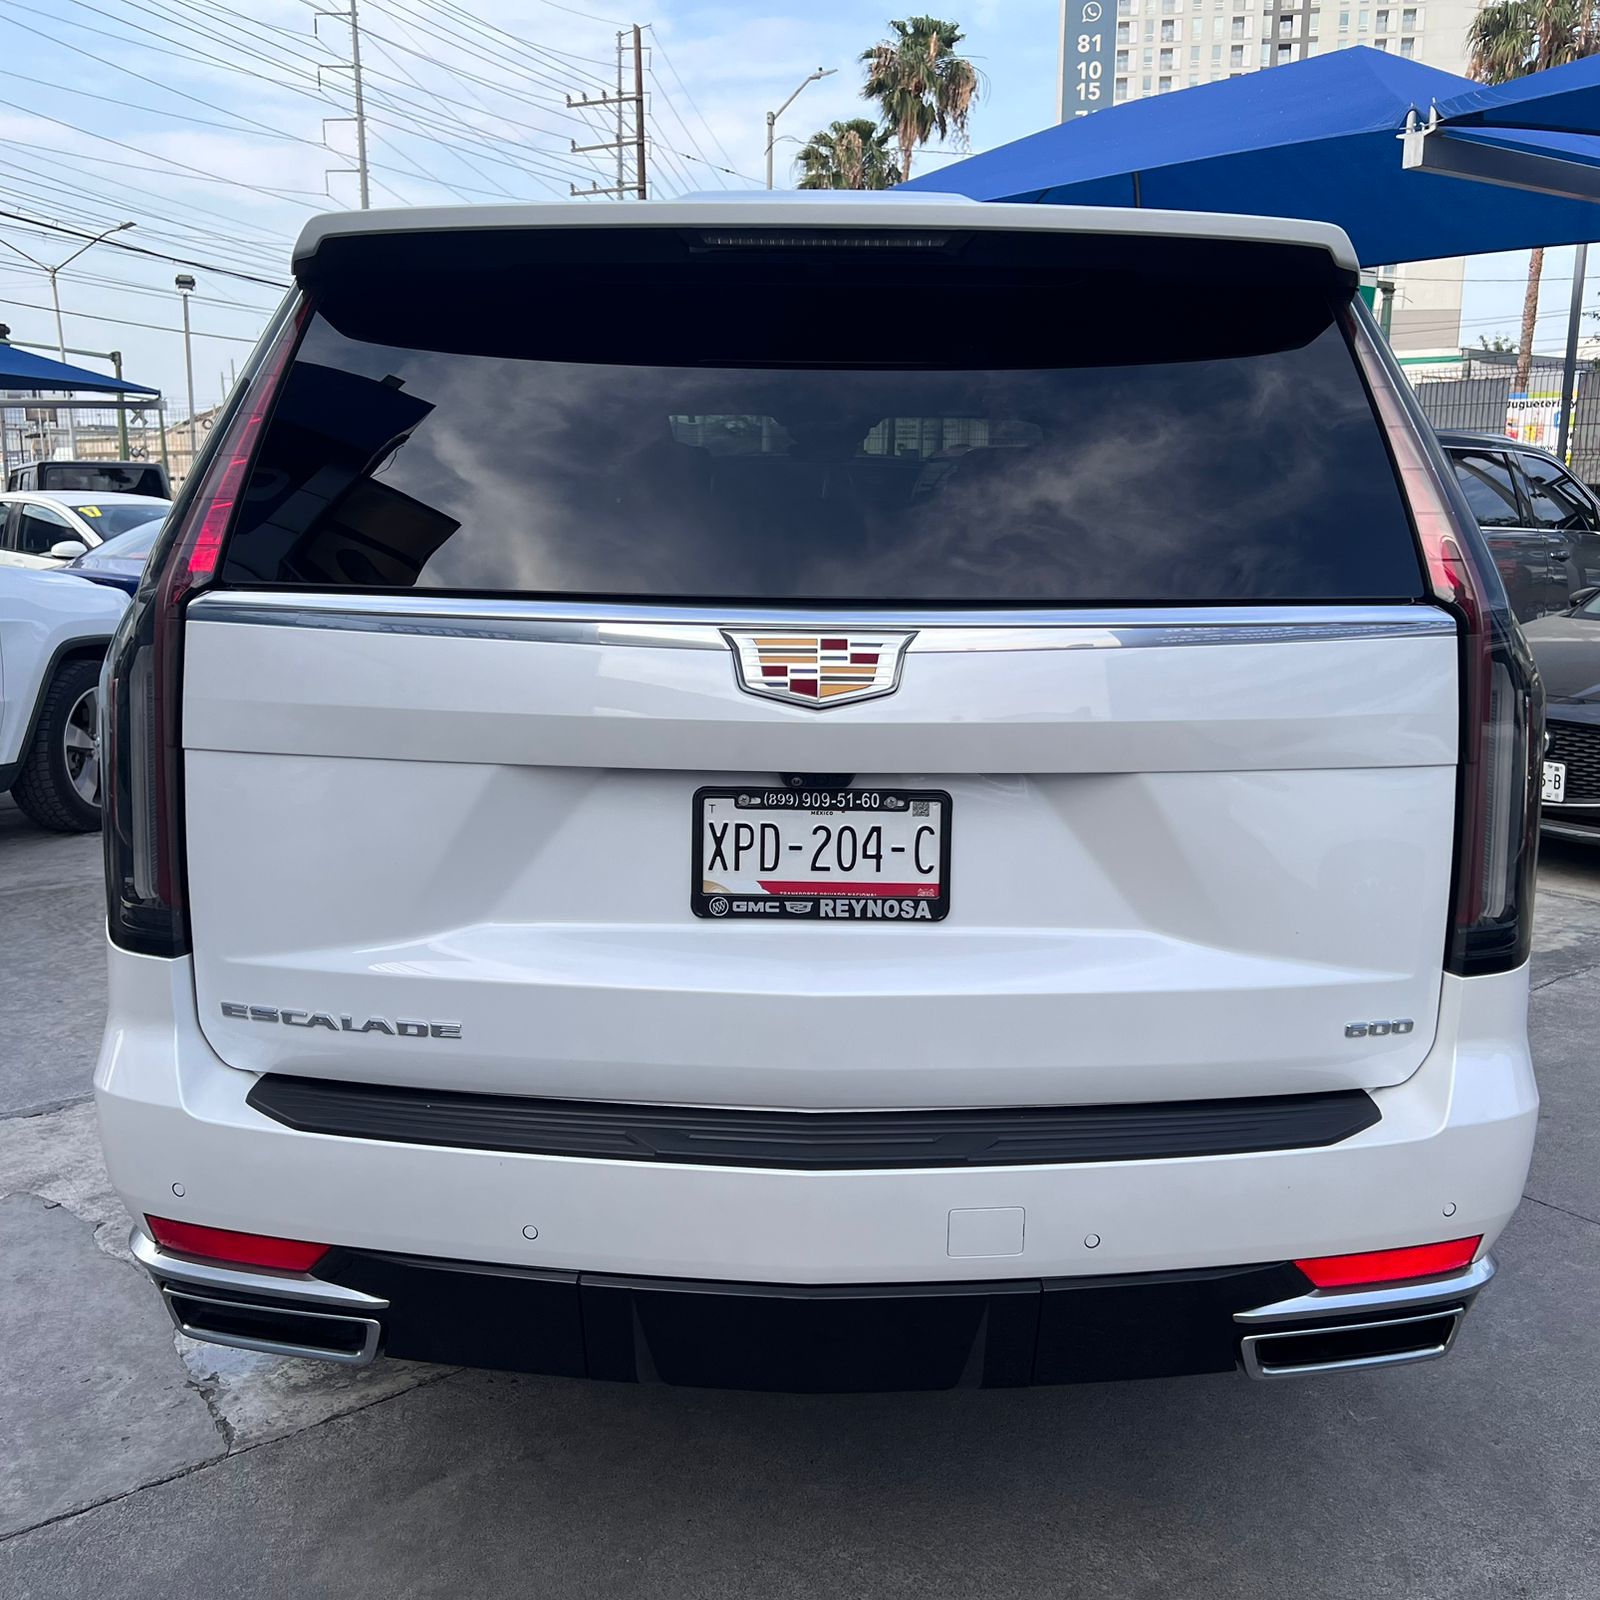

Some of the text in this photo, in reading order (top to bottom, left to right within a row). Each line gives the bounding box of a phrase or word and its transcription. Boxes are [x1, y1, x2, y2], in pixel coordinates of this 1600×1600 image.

[1077, 34, 1101, 53] 81
[1076, 61, 1102, 80] 10
[1076, 82, 1100, 100] 15
[764, 792, 880, 808] (899) 909-51-60
[708, 822, 935, 874] XPD-204-C
[732, 899, 932, 919] GMC REYNOSA
[221, 1001, 462, 1039] ESCALADE
[1344, 1018, 1414, 1038] 600
